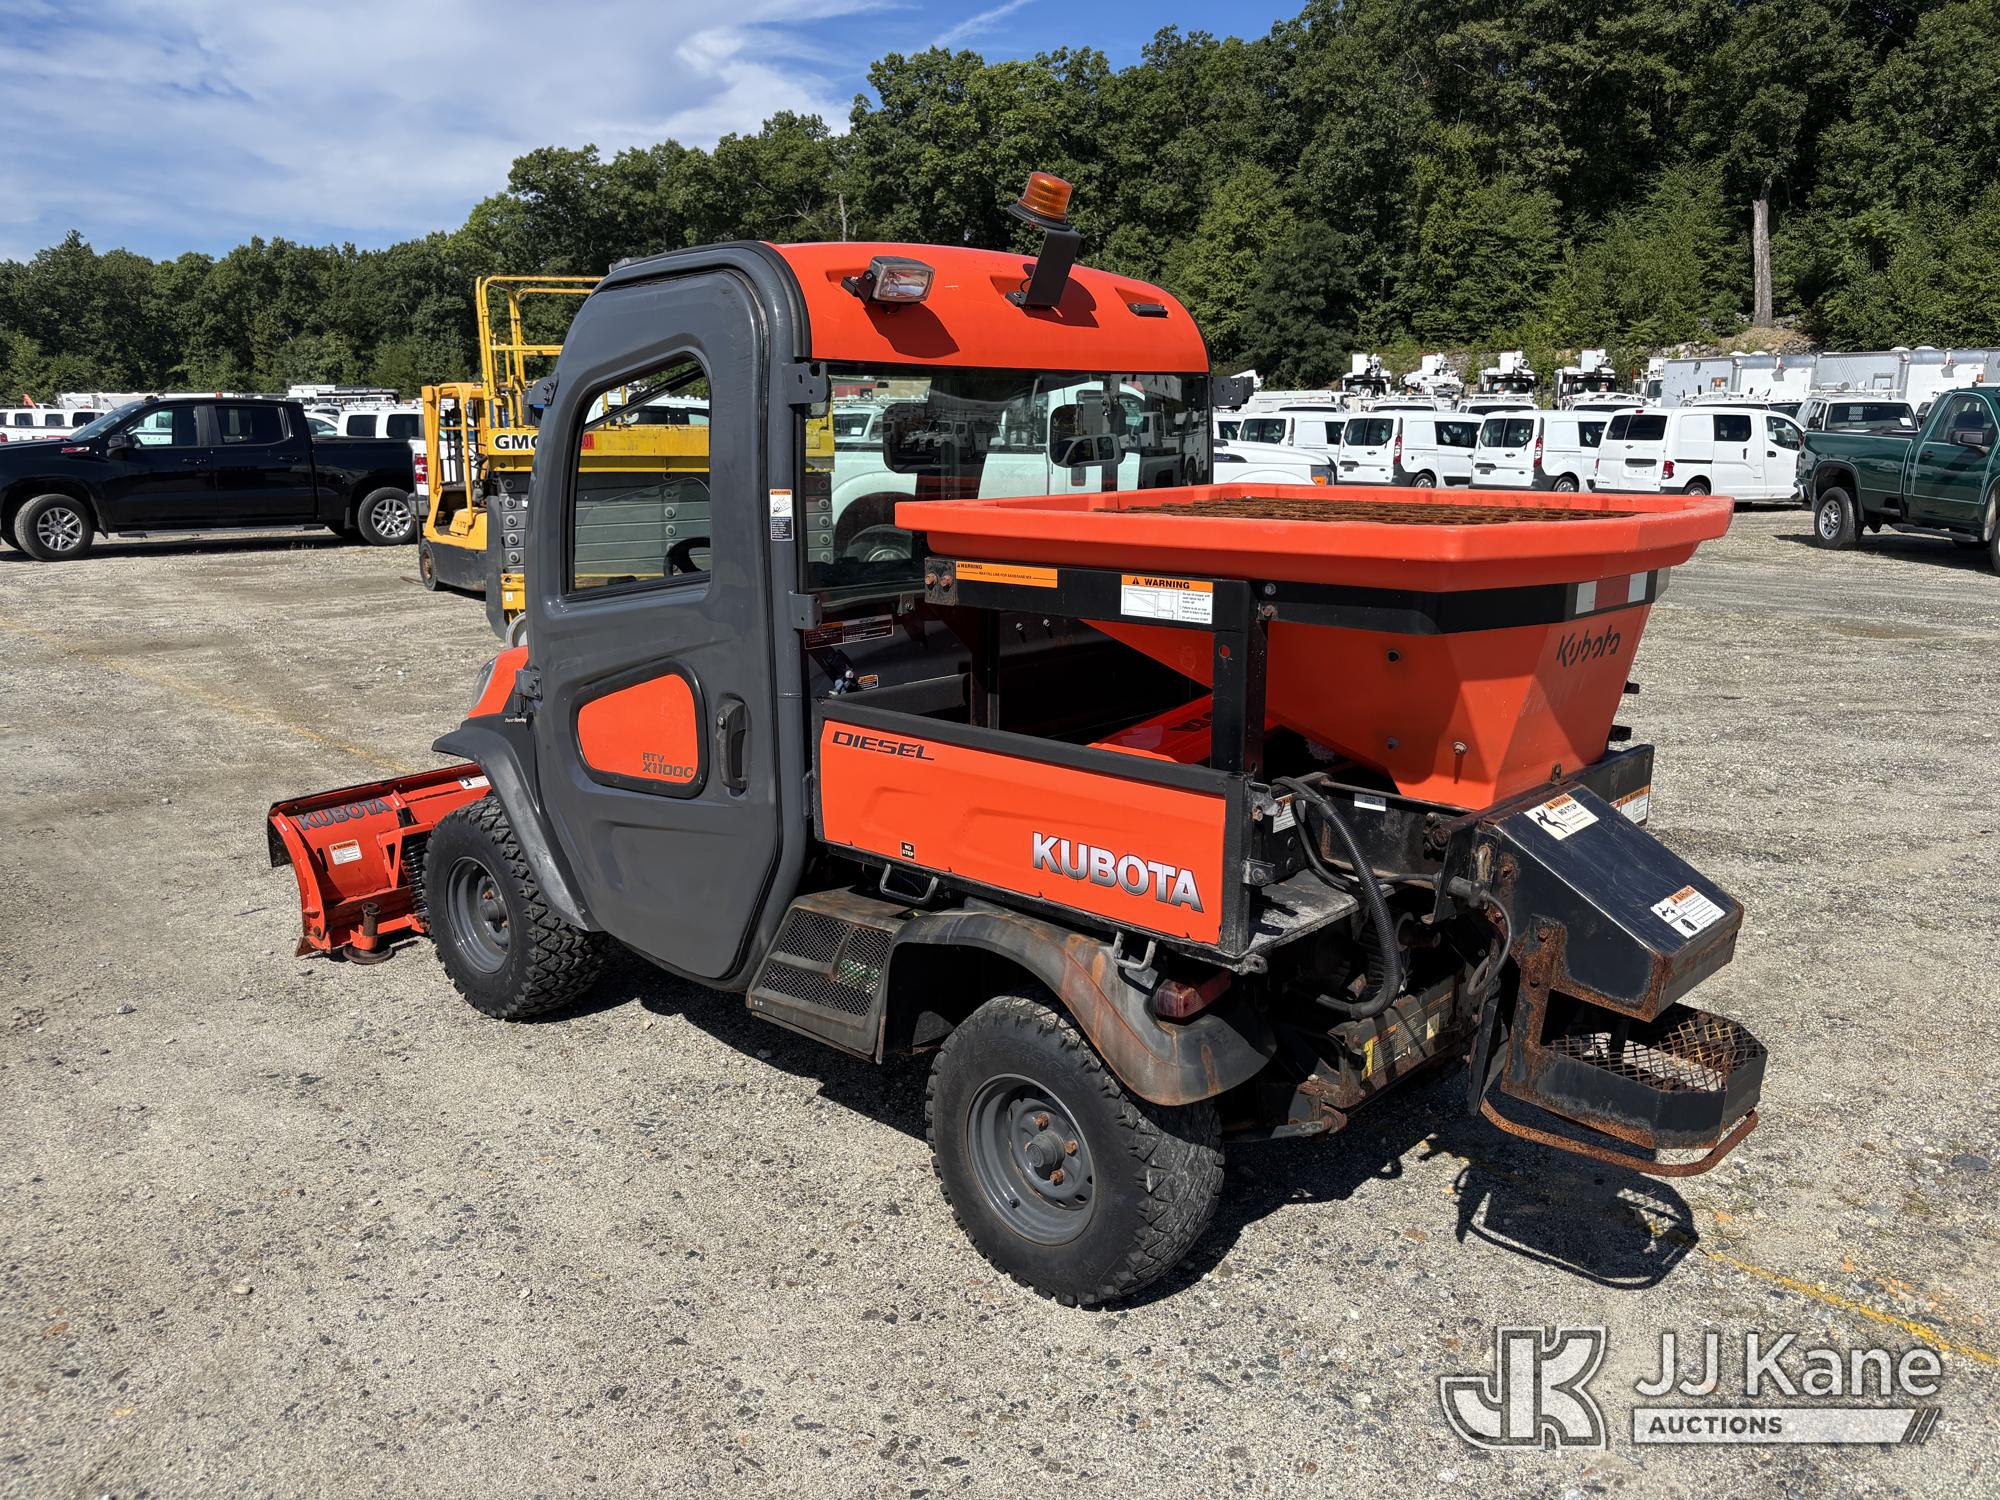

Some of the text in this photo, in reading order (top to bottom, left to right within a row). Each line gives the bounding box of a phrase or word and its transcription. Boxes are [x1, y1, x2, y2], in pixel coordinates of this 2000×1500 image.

[1144, 578, 1190, 590] WARNING
[1556, 624, 1621, 667] Kubota
[643, 752, 664, 763] RTV
[833, 731, 935, 760] DIESEL
[642, 761, 694, 778] X1100C
[295, 798, 394, 831] KUBOTA
[1032, 831, 1204, 913] KUBOTA
